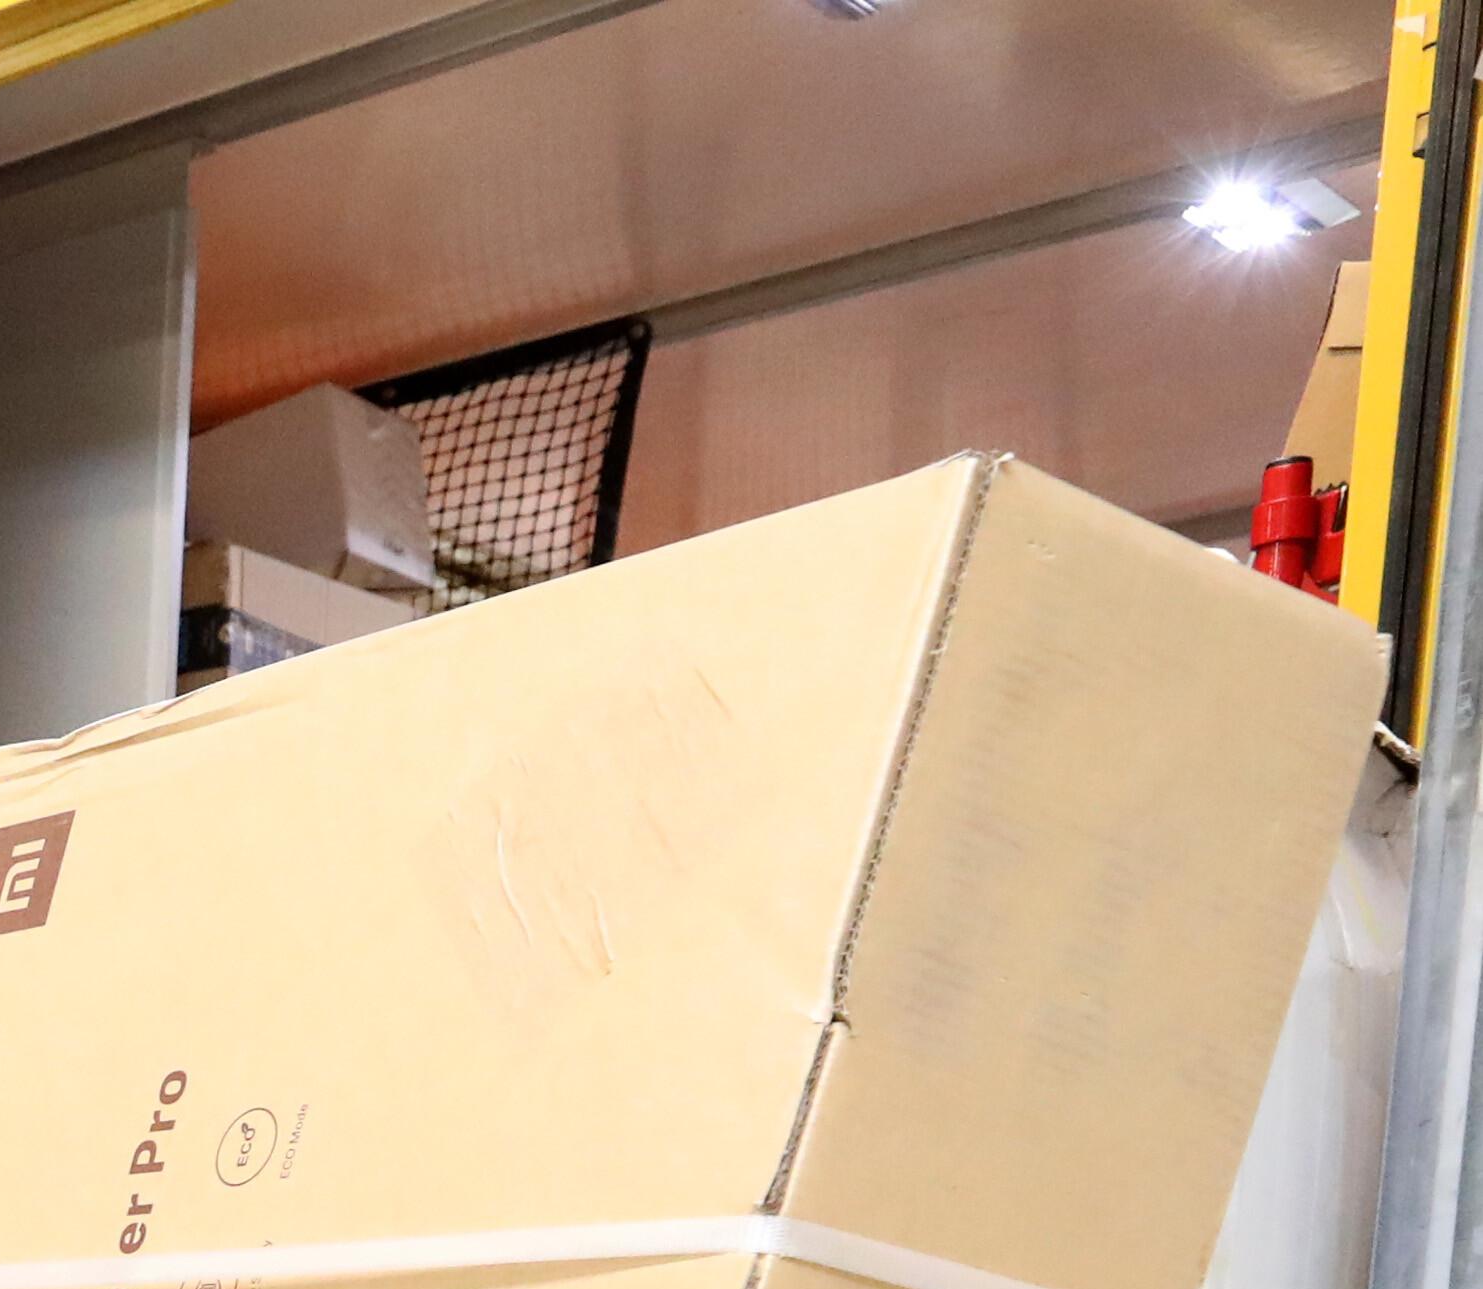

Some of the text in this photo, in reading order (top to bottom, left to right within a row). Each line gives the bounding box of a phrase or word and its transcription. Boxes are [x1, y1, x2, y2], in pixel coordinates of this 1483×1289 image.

[128, 1070, 188, 1175] Pro
[279, 1103, 309, 1180] ECO Mode
